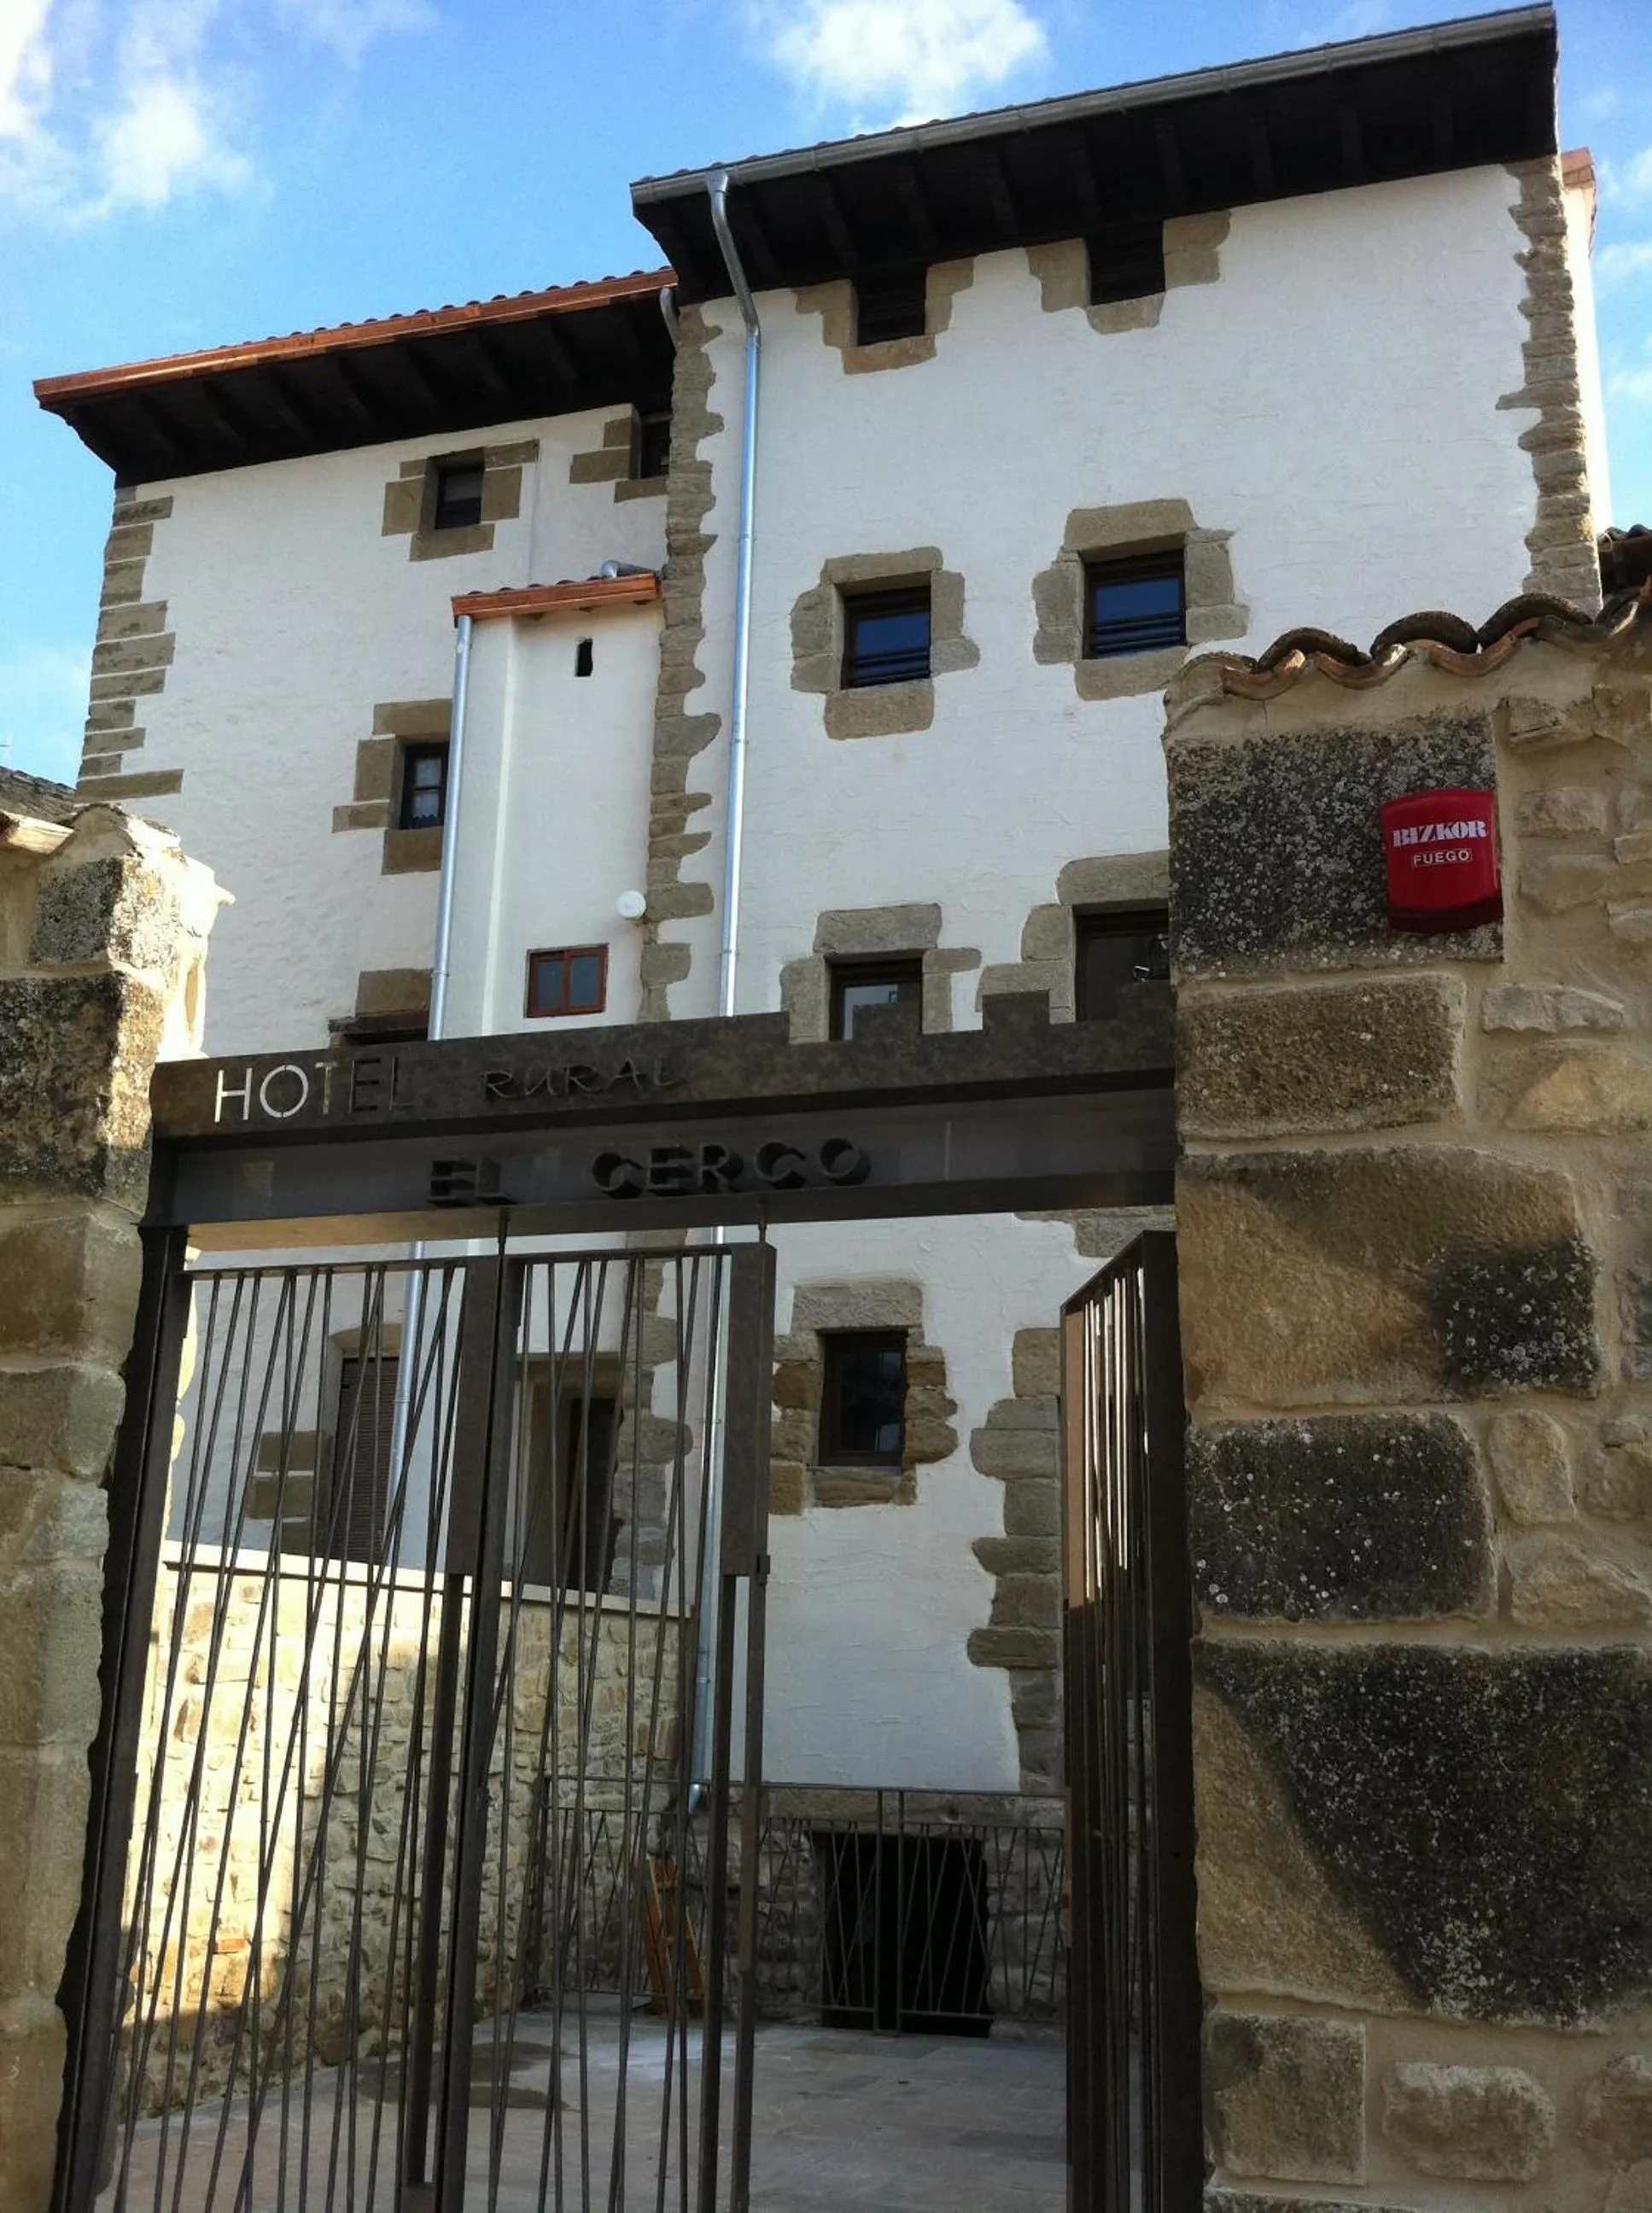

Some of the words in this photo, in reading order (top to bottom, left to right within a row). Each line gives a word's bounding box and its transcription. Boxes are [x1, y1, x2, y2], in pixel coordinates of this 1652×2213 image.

[1392, 820, 1487, 847] BIZKOR
[1413, 850, 1470, 866] FUEGO
[213, 1054, 417, 1124] HOTEL
[481, 1055, 686, 1101] RURAL
[429, 1157, 510, 1207] EL
[591, 1136, 867, 1200] CERCO
